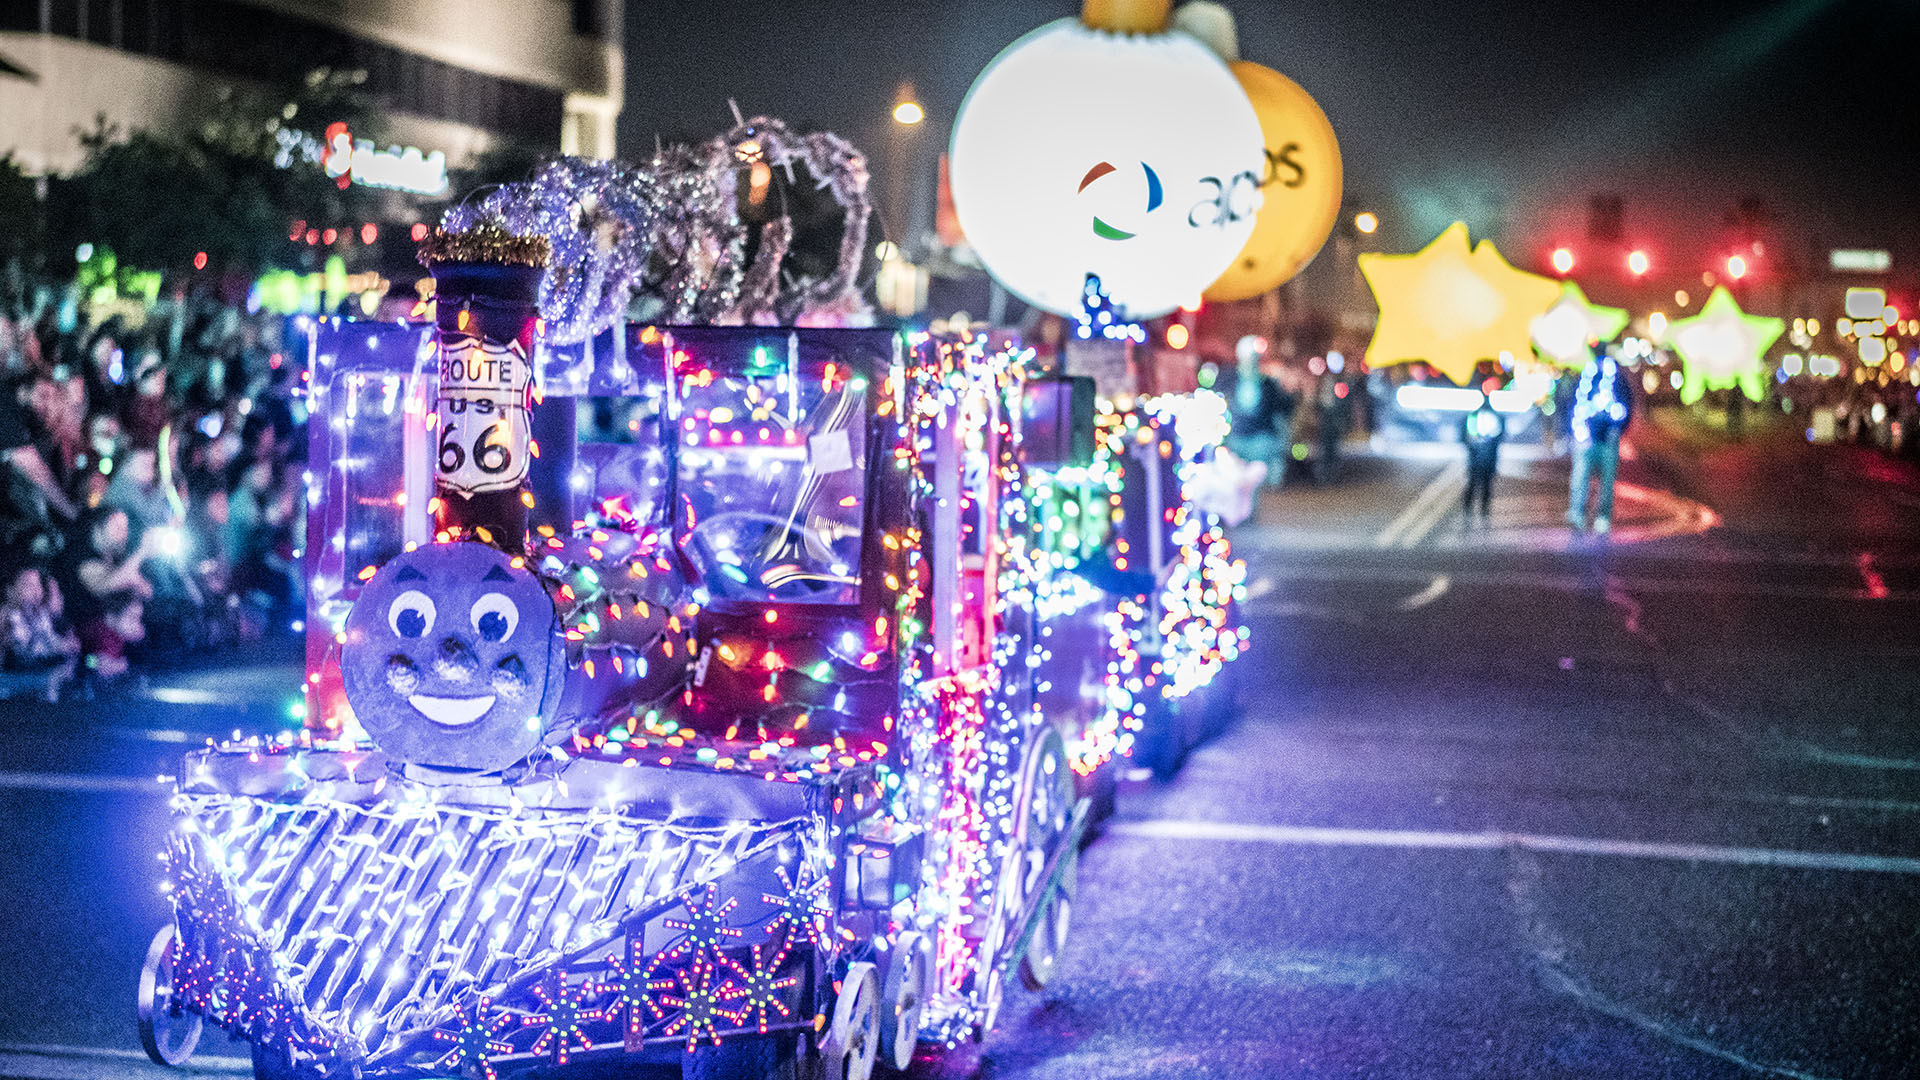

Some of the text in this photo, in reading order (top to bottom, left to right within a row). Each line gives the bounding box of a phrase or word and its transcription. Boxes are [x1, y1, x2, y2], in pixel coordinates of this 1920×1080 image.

[441, 359, 512, 383] ROUTE
[449, 397, 495, 414] US
[439, 422, 512, 474] 66
